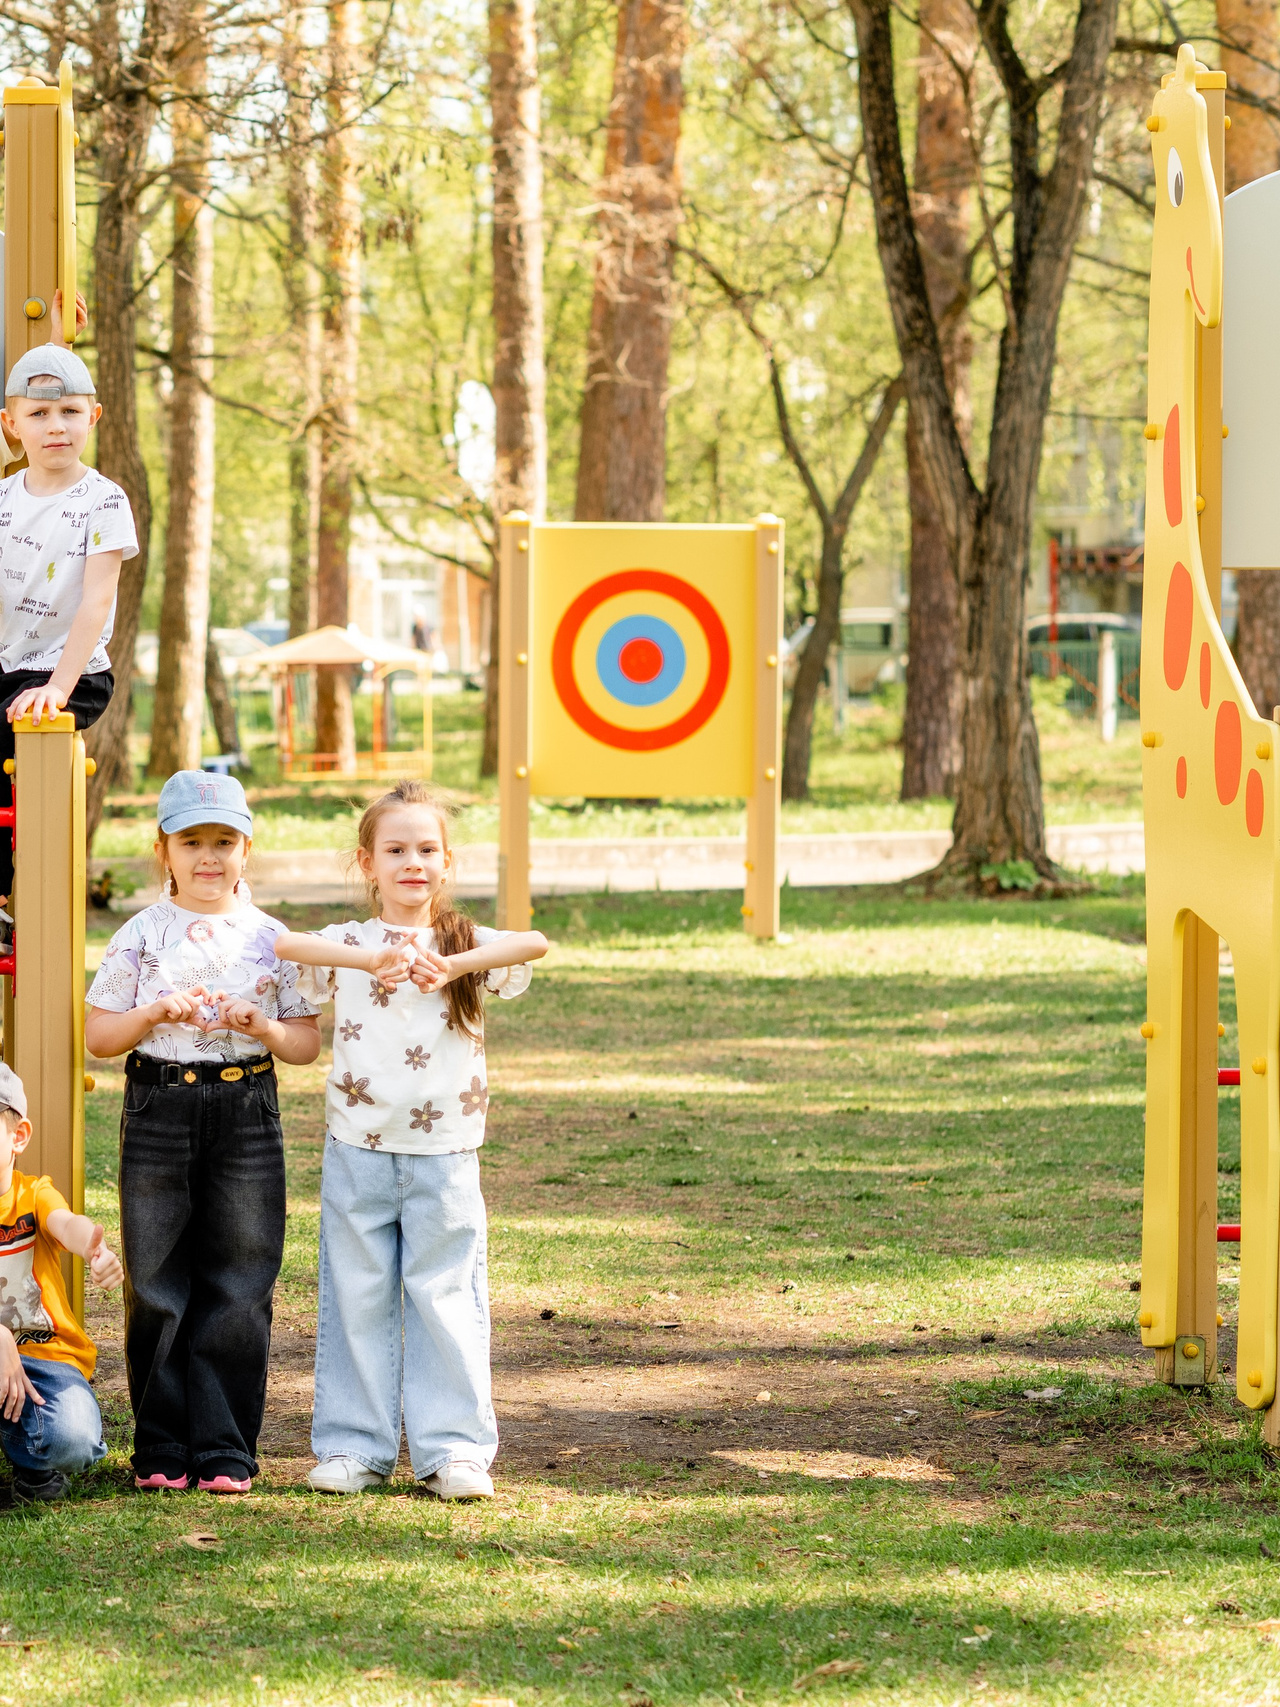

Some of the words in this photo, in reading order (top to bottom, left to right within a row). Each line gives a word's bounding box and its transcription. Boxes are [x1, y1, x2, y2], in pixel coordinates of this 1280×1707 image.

[21, 597, 37, 607] HAPPY
[14, 606, 34, 616] FOREVER
[43, 610, 58, 618] EVER
